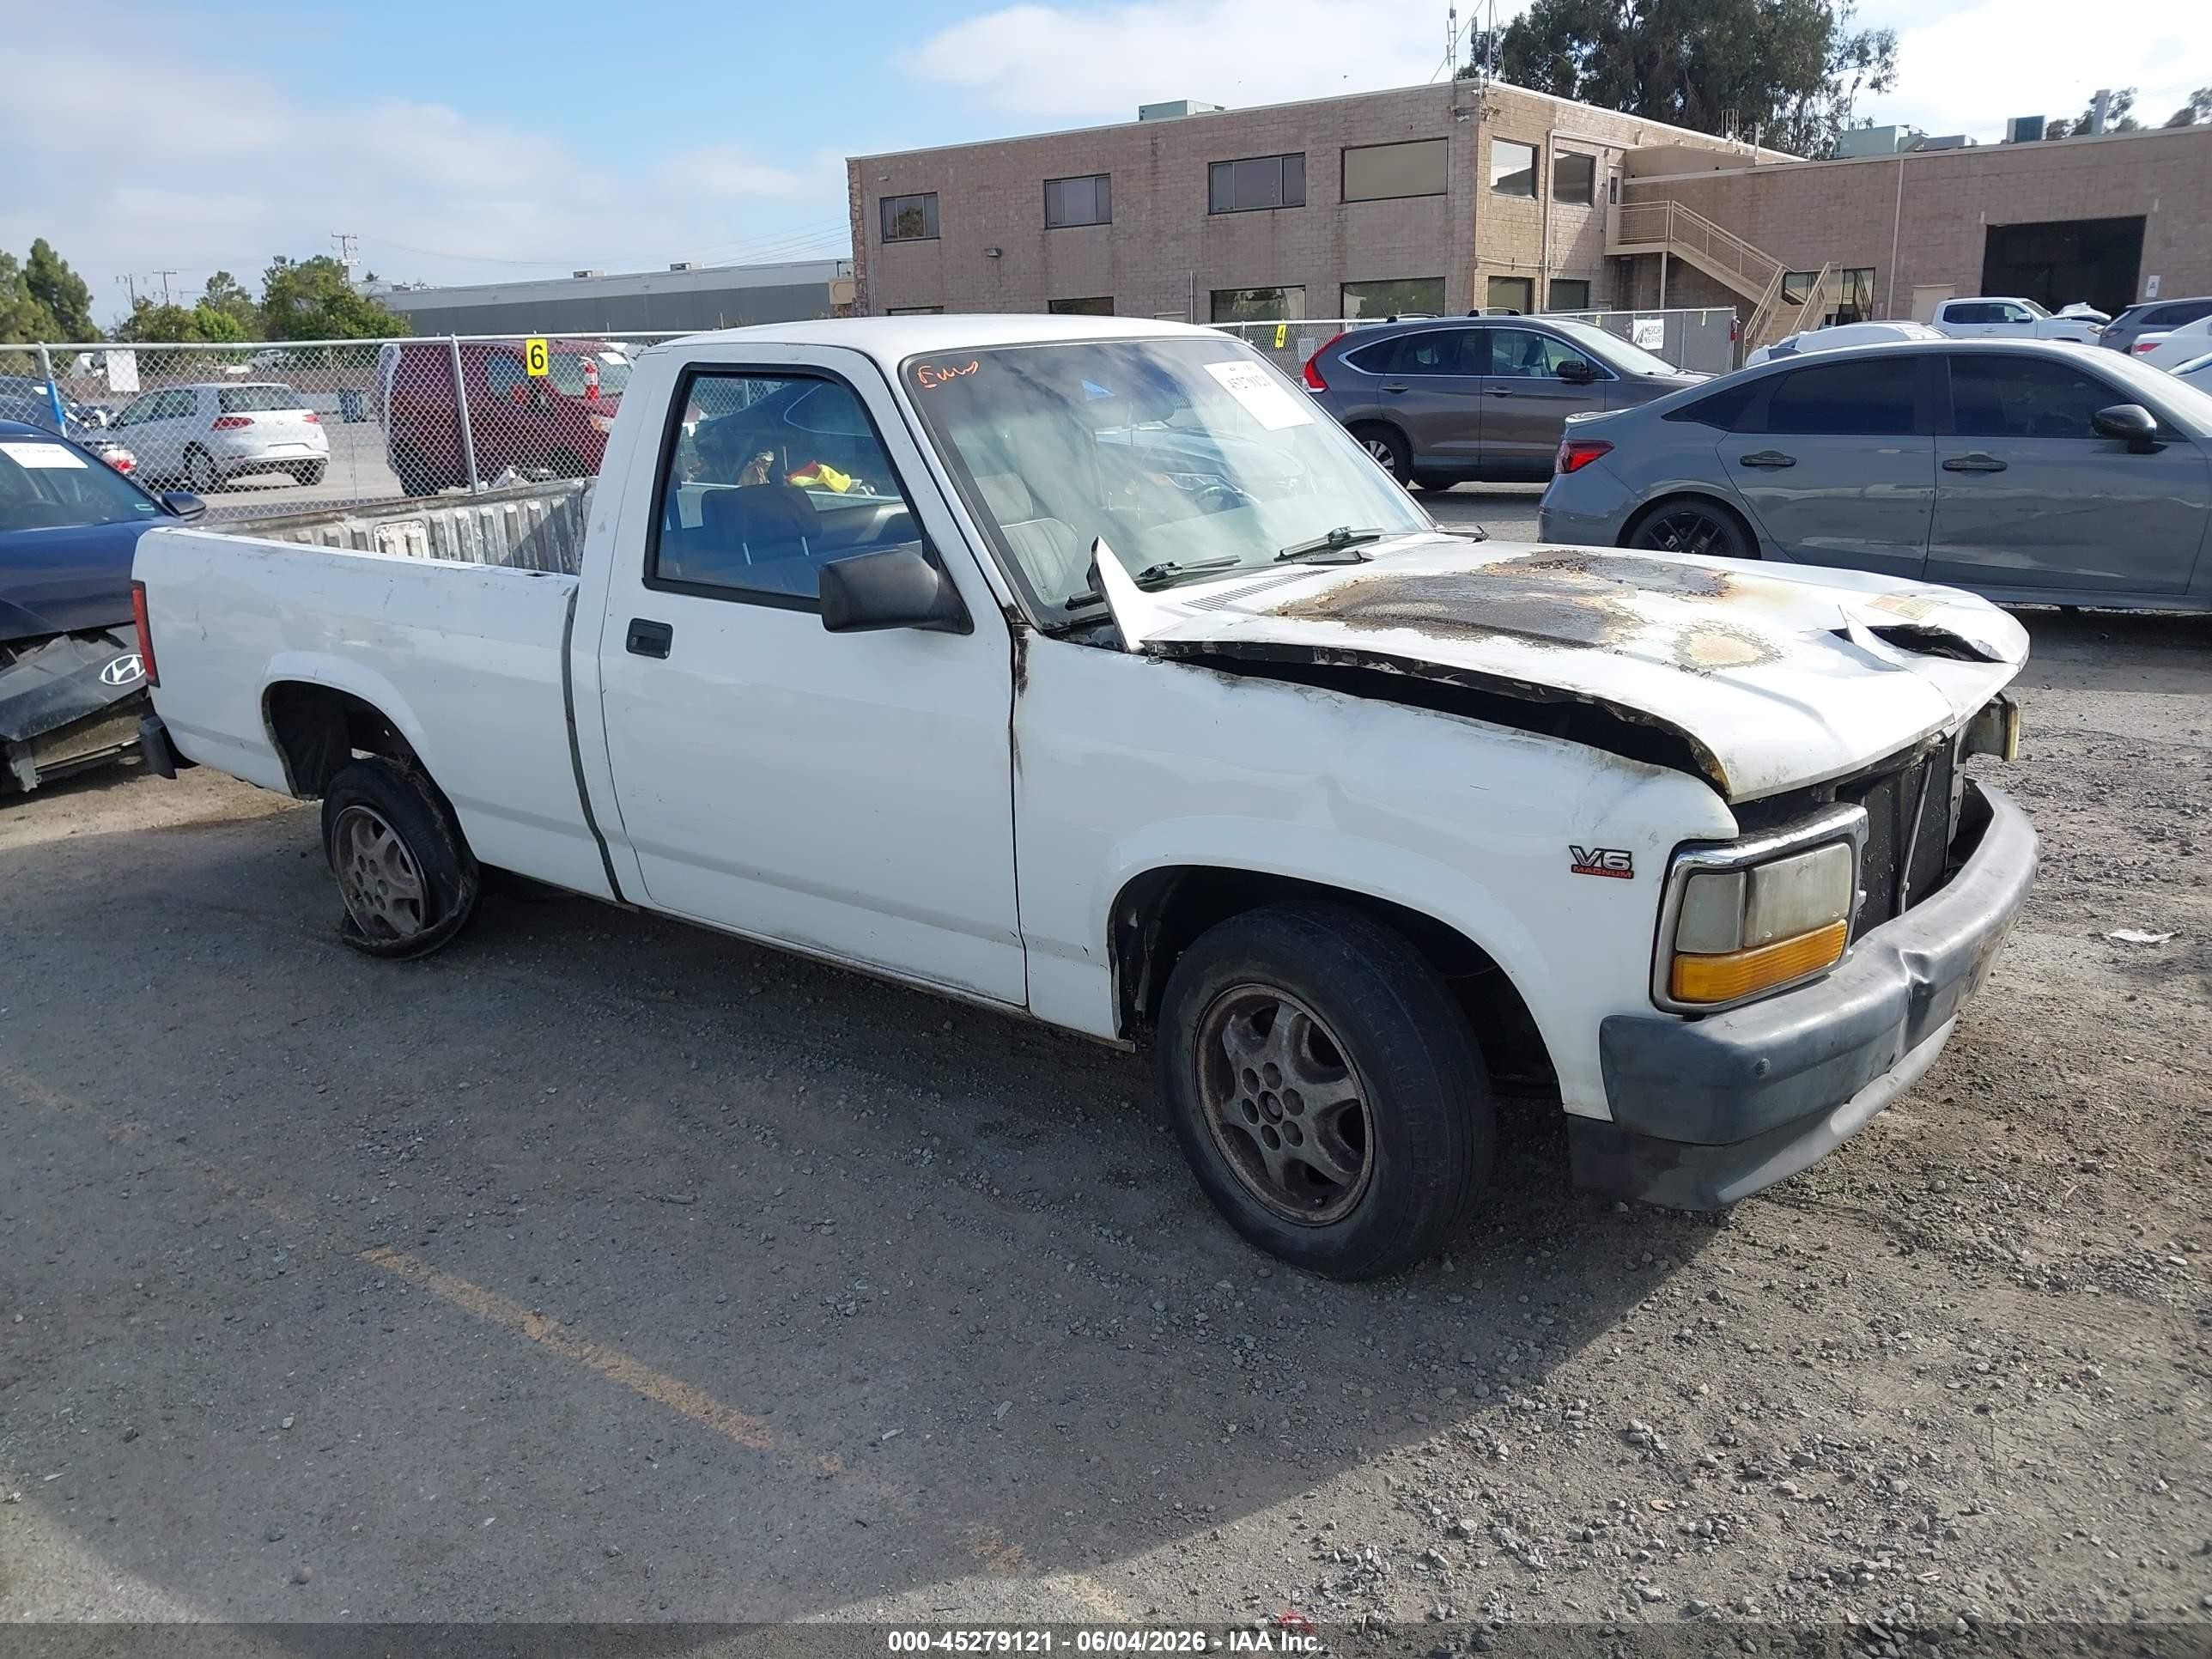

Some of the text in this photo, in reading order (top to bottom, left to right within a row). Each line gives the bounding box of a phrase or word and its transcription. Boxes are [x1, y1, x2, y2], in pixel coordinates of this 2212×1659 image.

[1278, 327, 1284, 343] 4
[531, 344, 544, 369] 6
[1569, 845, 1632, 870] V6
[1573, 866, 1632, 878] MAGNUM
